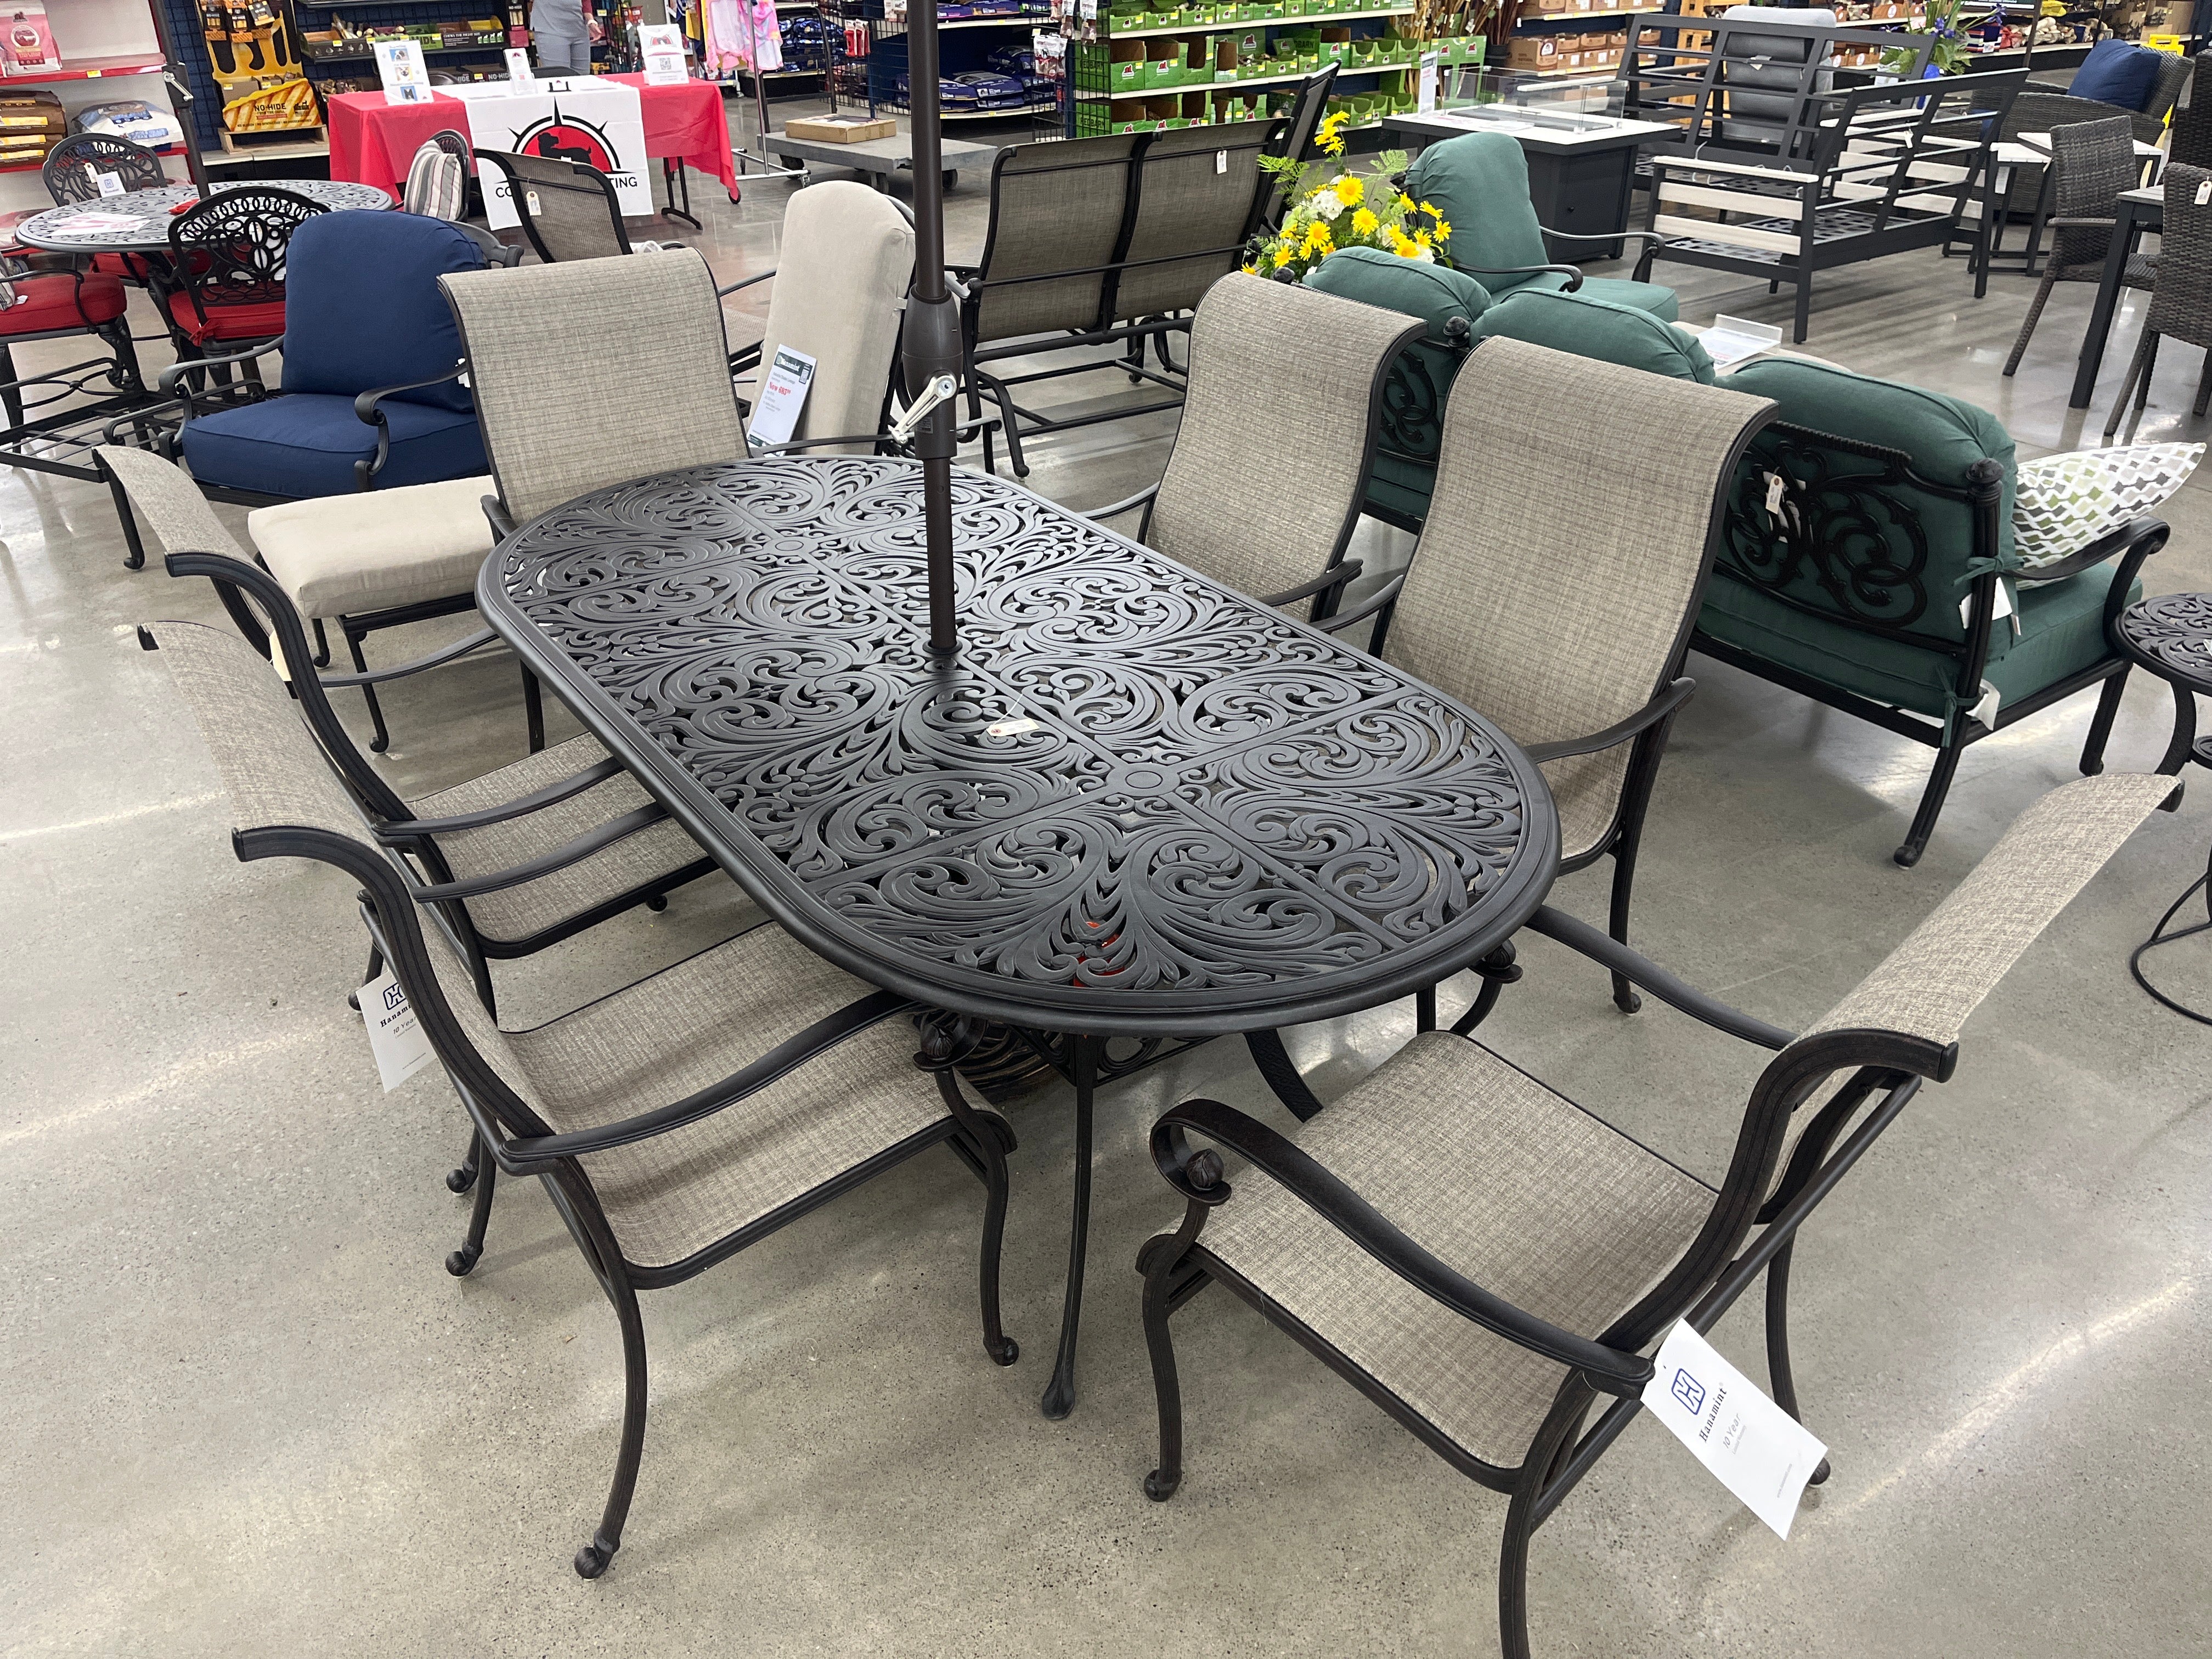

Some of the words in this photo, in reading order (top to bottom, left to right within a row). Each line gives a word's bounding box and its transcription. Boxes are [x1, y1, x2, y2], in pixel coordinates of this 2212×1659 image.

[255, 103, 286, 111] NO-HIDE
[380, 1004, 412, 1028] Hanami
[1699, 1387, 1728, 1443] Hanamint
[1726, 1413, 1741, 1437] Year
[1723, 1436, 1731, 1449] 10
